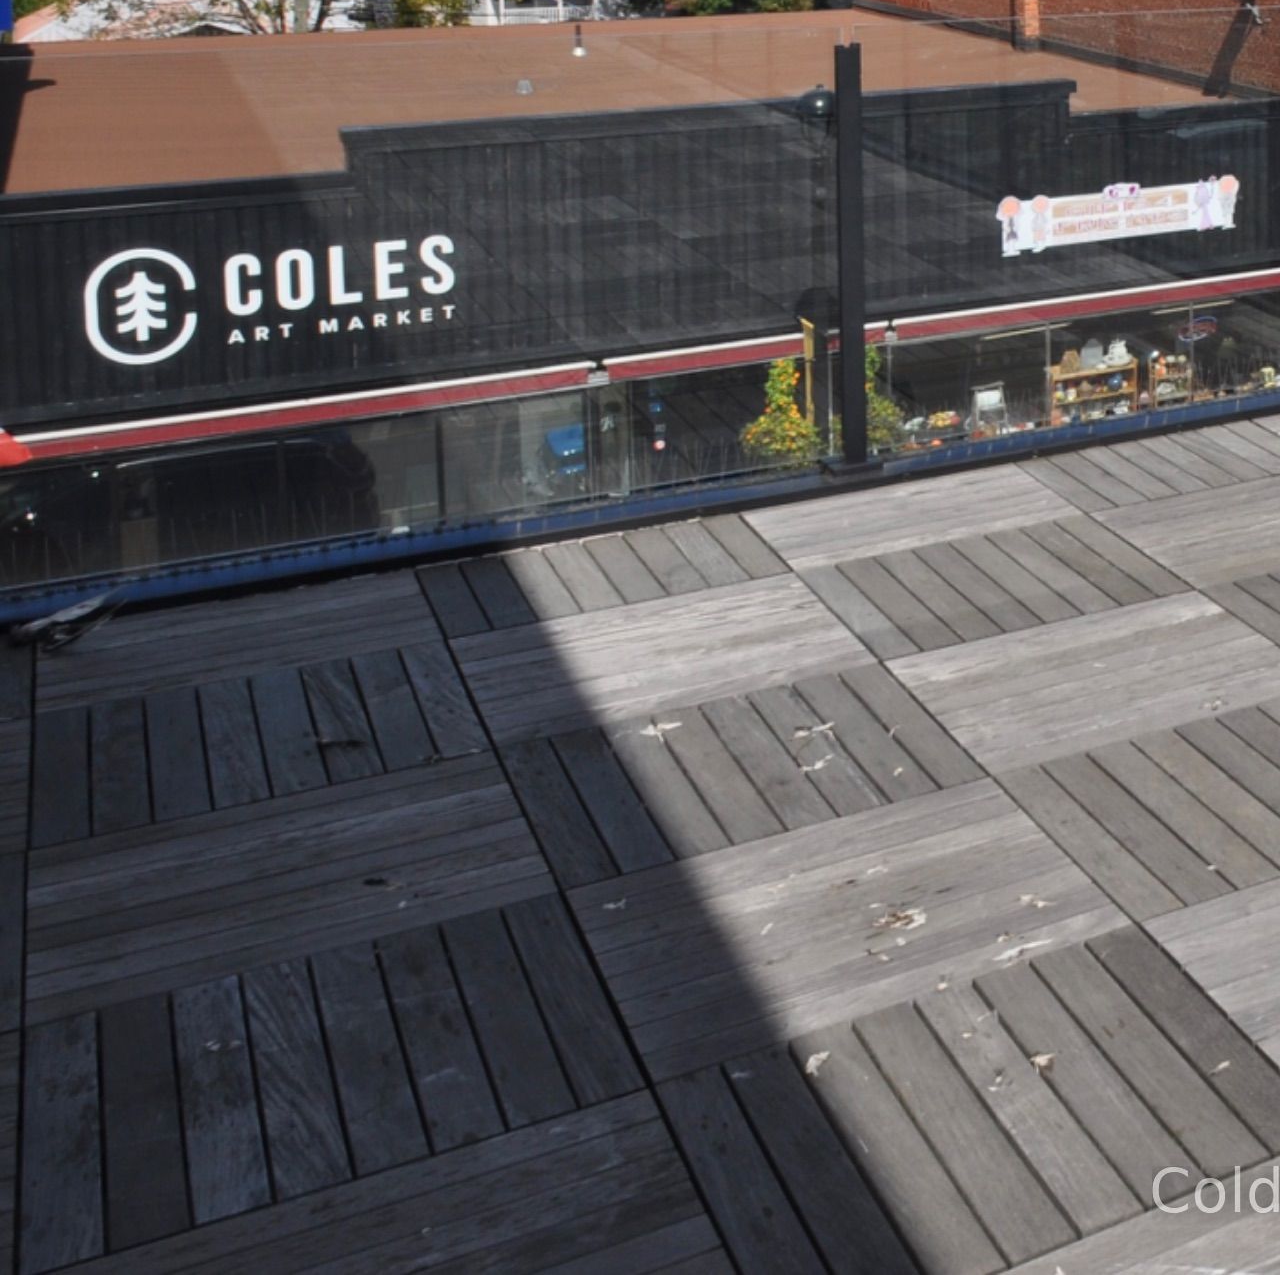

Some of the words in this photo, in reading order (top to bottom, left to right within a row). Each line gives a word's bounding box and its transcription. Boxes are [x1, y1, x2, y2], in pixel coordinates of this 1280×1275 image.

[223, 234, 455, 316] COLES
[227, 323, 294, 345] ART
[319, 305, 456, 334] MARKET
